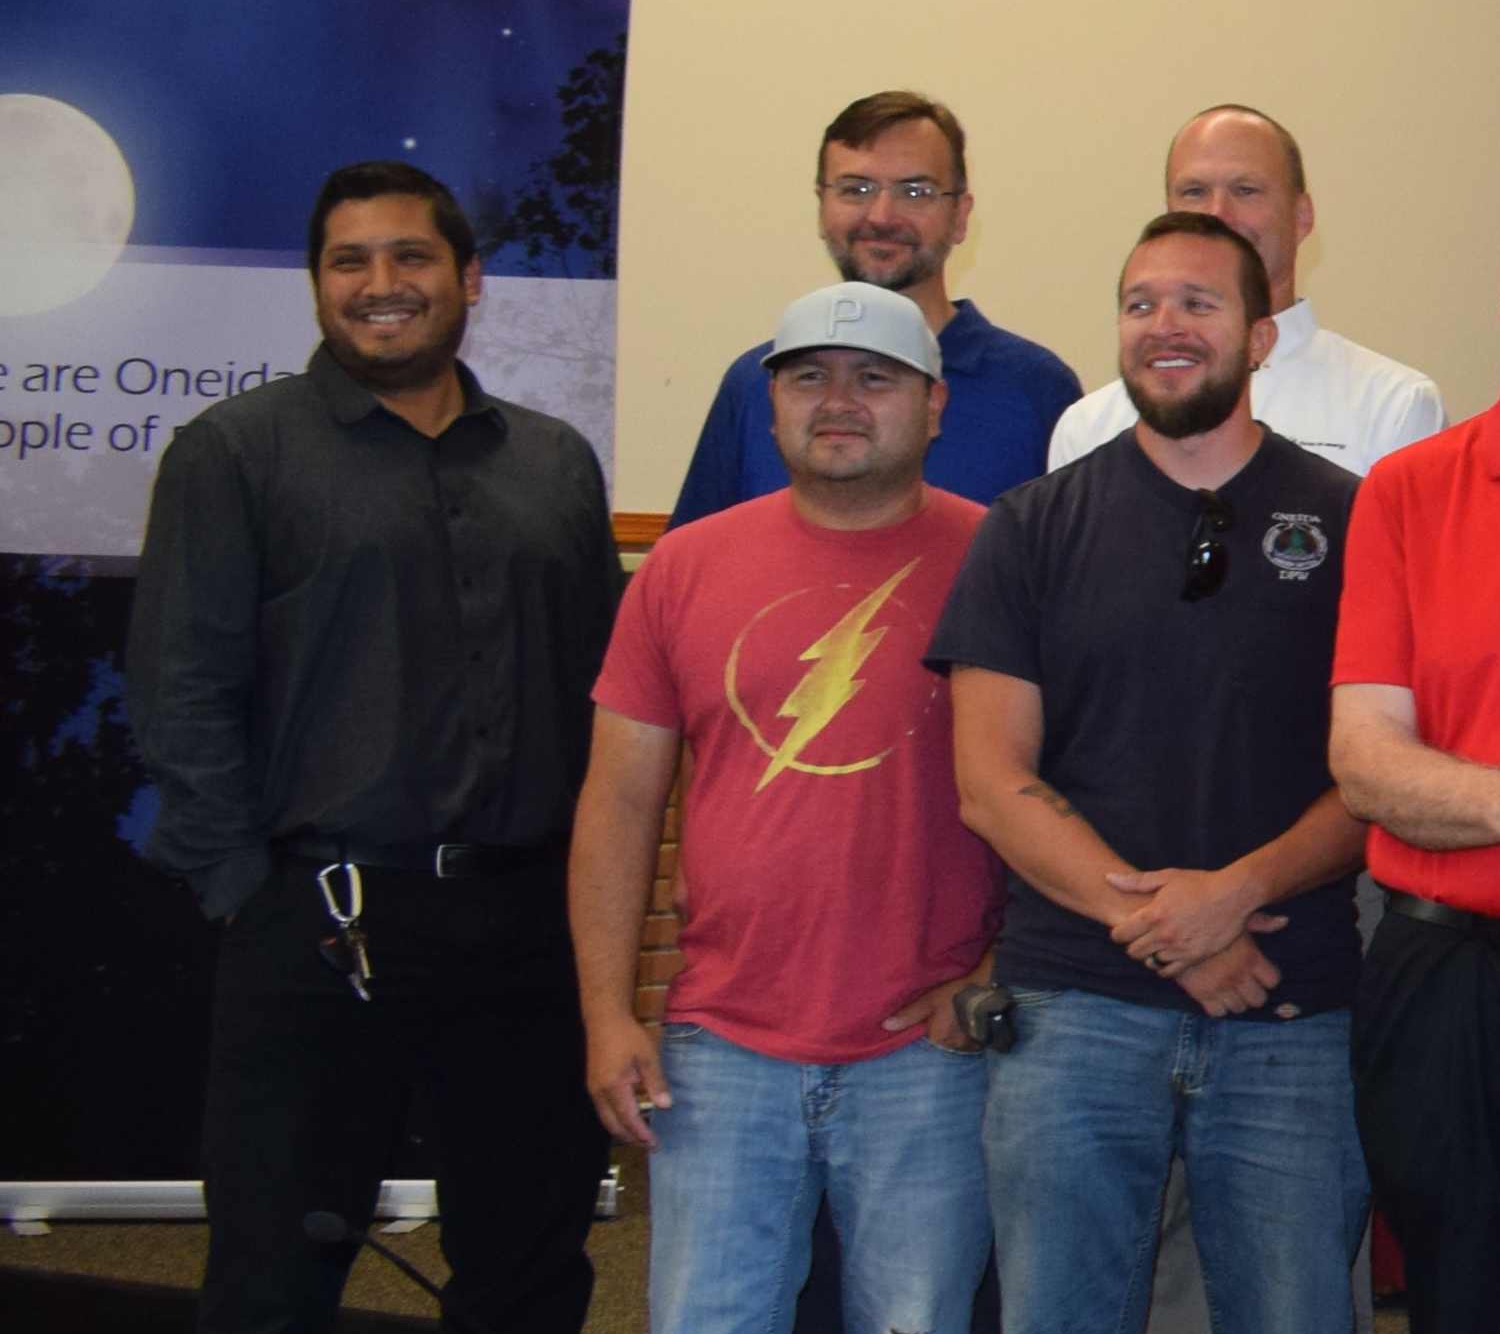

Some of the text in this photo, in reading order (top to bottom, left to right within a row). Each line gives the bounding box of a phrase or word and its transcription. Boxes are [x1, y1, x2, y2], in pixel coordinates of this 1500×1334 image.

[827, 296, 863, 338] P
[22, 363, 100, 394] are
[108, 414, 160, 452] of
[1278, 569, 1310, 581] DPW
